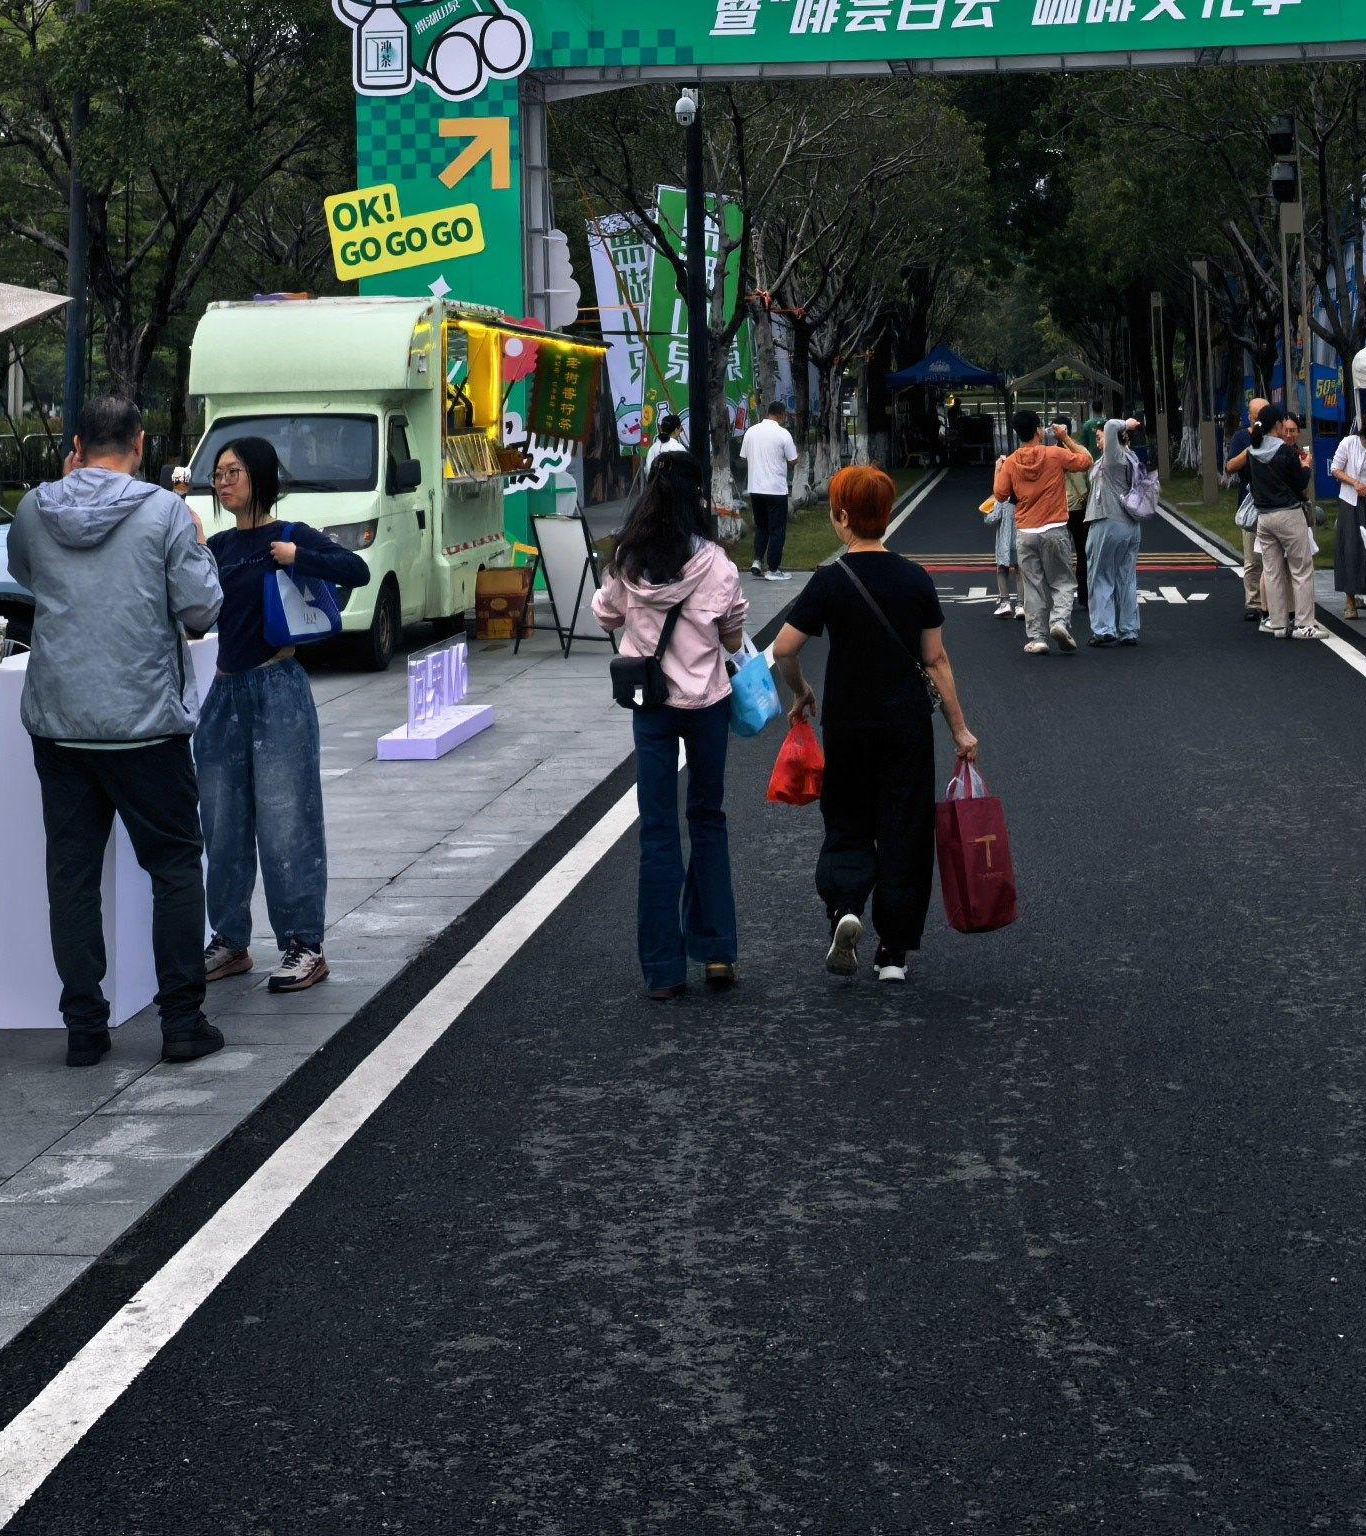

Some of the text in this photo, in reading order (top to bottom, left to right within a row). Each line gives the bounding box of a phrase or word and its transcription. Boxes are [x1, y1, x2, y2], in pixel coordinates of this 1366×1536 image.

[332, 195, 396, 234] OK!
[340, 217, 474, 267] GO GO GO
